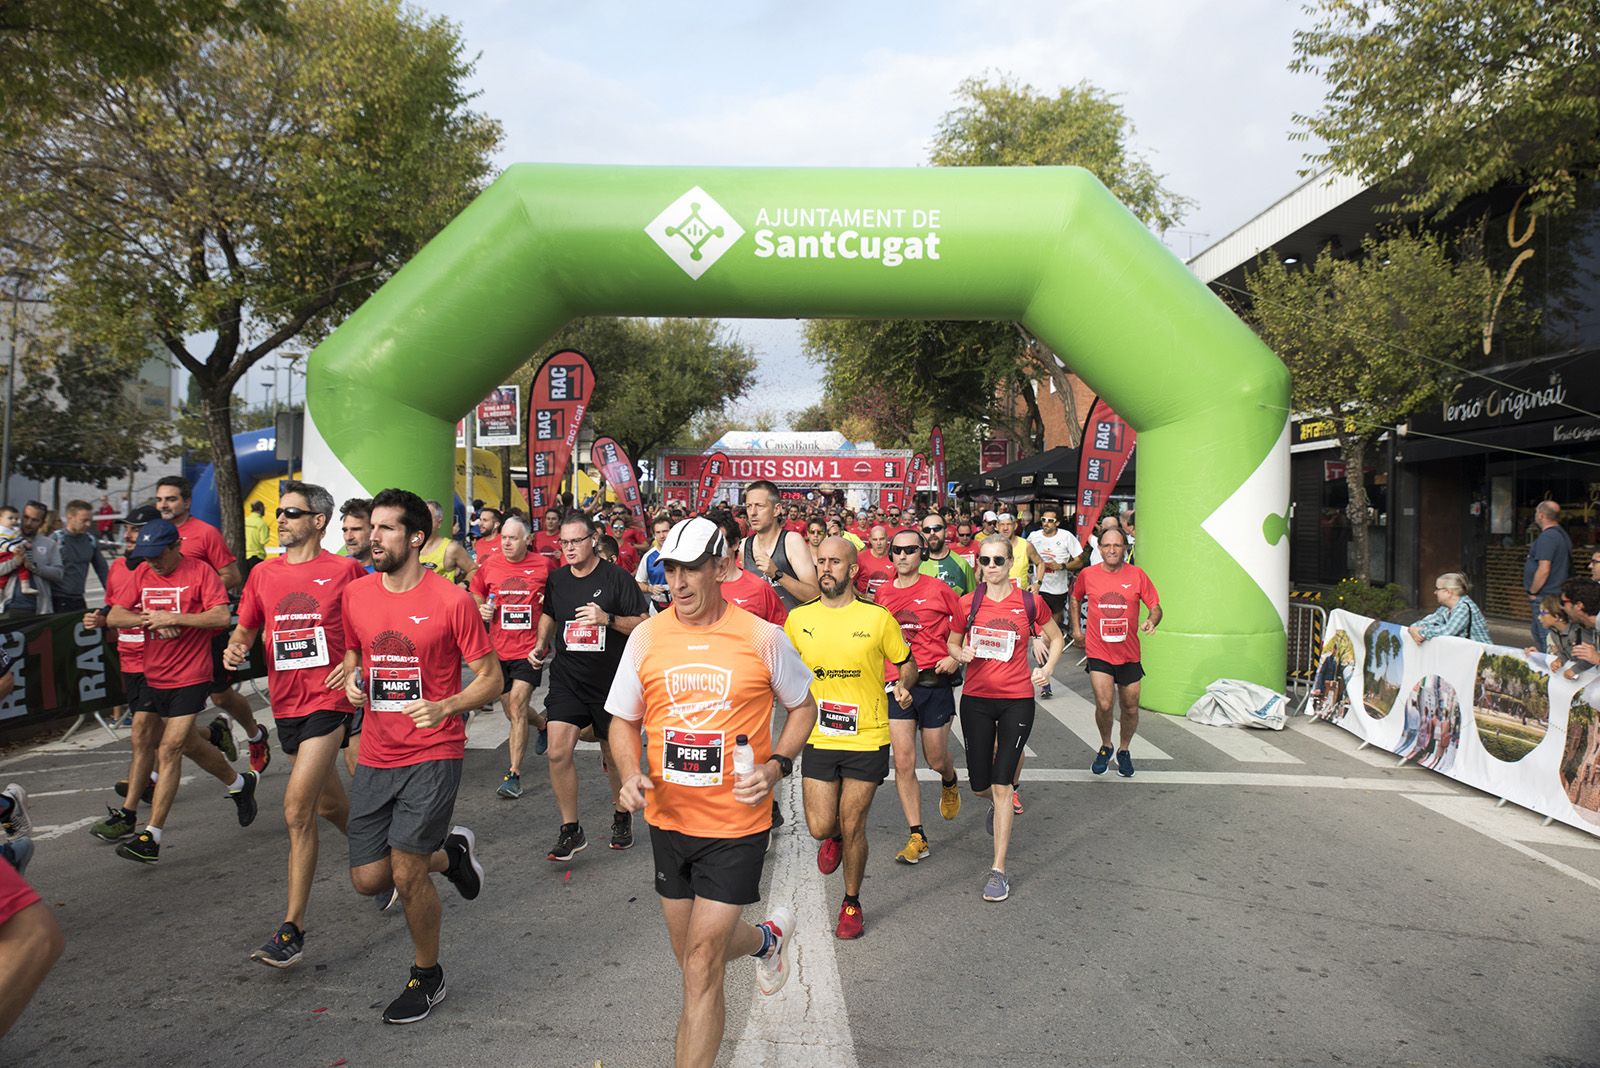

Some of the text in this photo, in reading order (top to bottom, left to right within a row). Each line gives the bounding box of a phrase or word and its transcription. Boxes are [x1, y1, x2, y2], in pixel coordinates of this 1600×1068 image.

[755, 208, 941, 228] AJUNTAMENT DE
[754, 229, 941, 267] SantCugat
[765, 439, 820, 450] CaixaBank
[729, 459, 841, 478] TOTS SOM 1
[284, 641, 308, 651] LLUIS
[74, 621, 107, 702] RAC
[382, 681, 410, 691] MARC
[672, 672, 724, 696] BUNICUS
[825, 713, 850, 723] ALBERTO
[677, 746, 708, 761] PERE
[682, 761, 700, 772] 178
